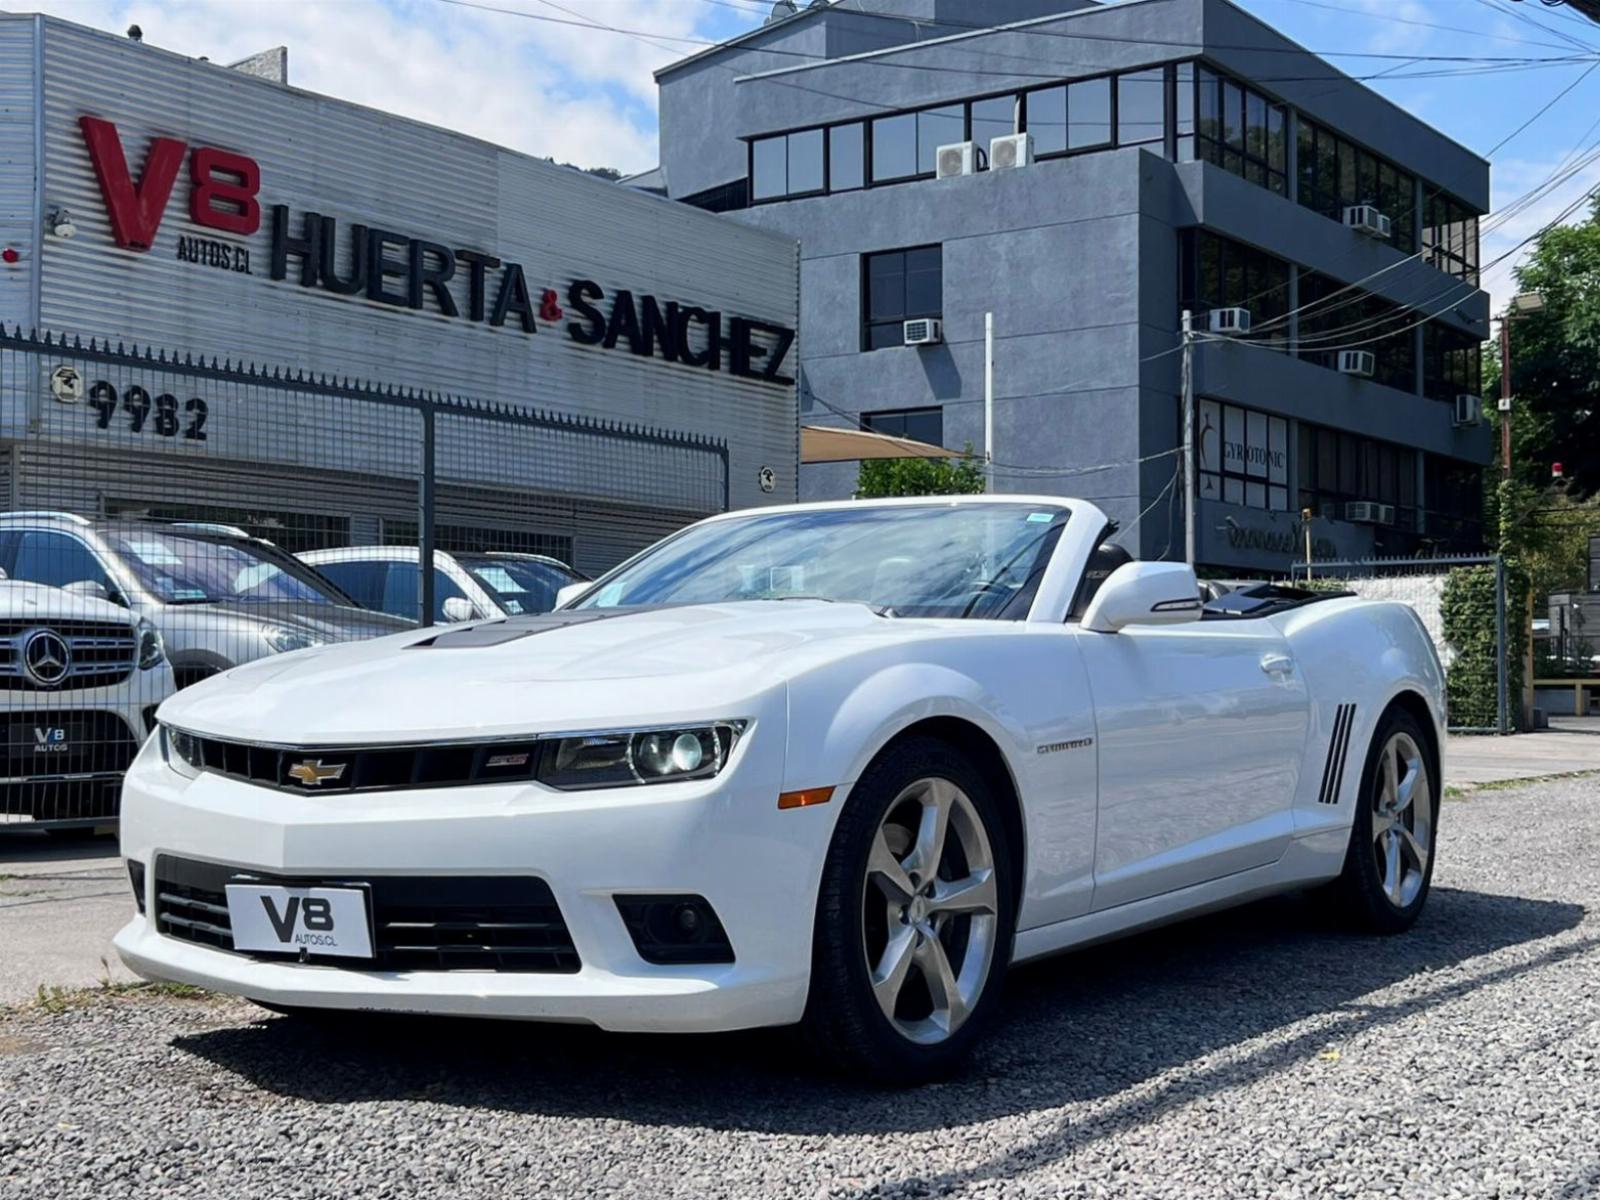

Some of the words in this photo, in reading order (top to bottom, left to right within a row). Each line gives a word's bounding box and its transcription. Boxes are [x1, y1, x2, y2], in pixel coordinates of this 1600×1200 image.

[78, 115, 261, 252] V8
[177, 234, 254, 276] AUTOS.CL
[269, 204, 538, 333] HUERTA
[539, 288, 564, 322] &
[567, 280, 796, 386] SANCHEZ
[88, 380, 209, 441] 9982
[34, 727, 66, 744] V8
[34, 743, 68, 752] AUTOS
[259, 895, 334, 943] V8
[294, 933, 339, 947] AUTOS.CL
